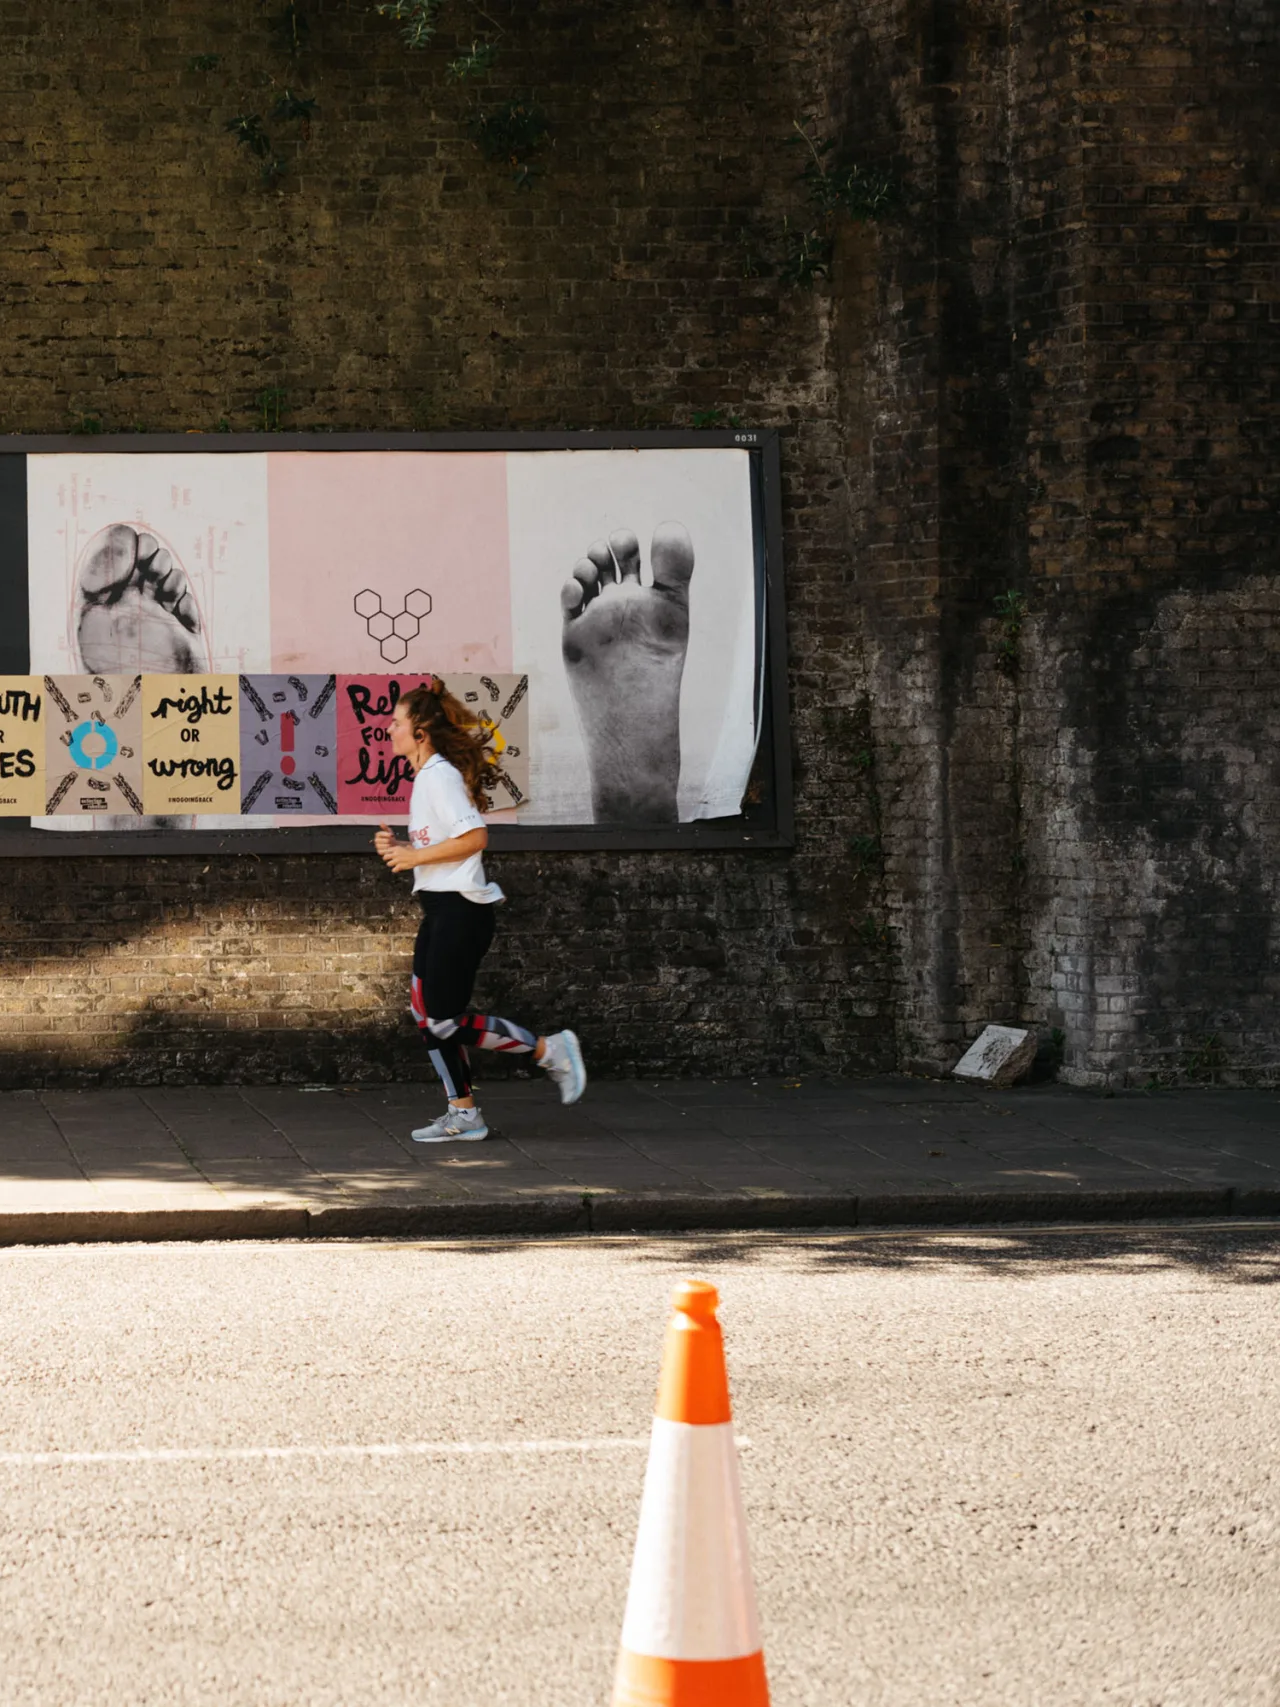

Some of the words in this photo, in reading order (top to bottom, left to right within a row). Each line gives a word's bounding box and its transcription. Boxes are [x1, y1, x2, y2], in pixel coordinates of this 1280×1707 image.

[151, 686, 232, 723] right
[180, 728, 200, 742] OR
[148, 757, 237, 790] wrong
